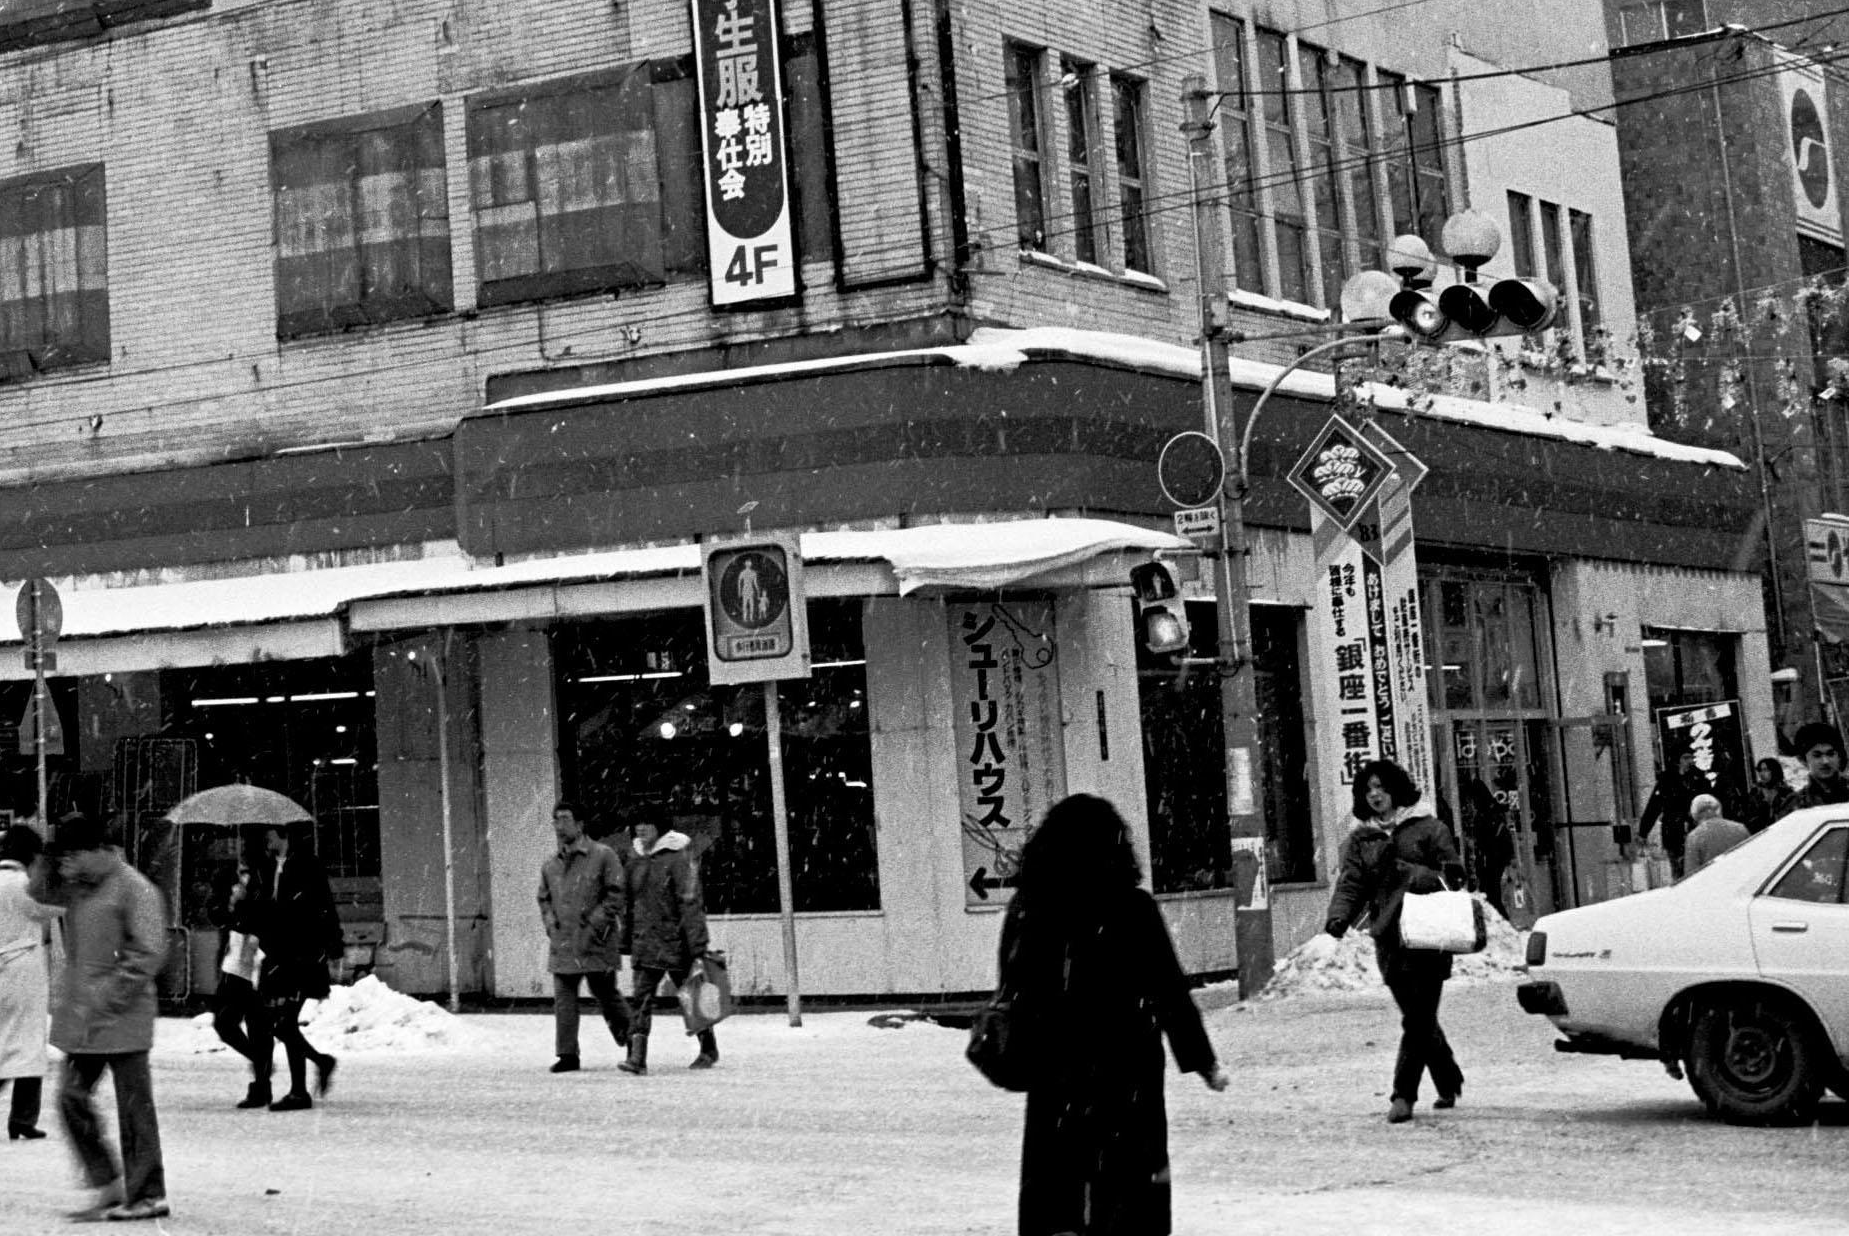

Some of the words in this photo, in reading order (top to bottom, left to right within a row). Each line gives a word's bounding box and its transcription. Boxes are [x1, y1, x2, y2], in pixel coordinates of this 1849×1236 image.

[713, 108, 747, 201] 奉仕会
[744, 102, 773, 166] 特別
[724, 244, 779, 287] 4F
[962, 611, 1011, 828] シューリハウス
